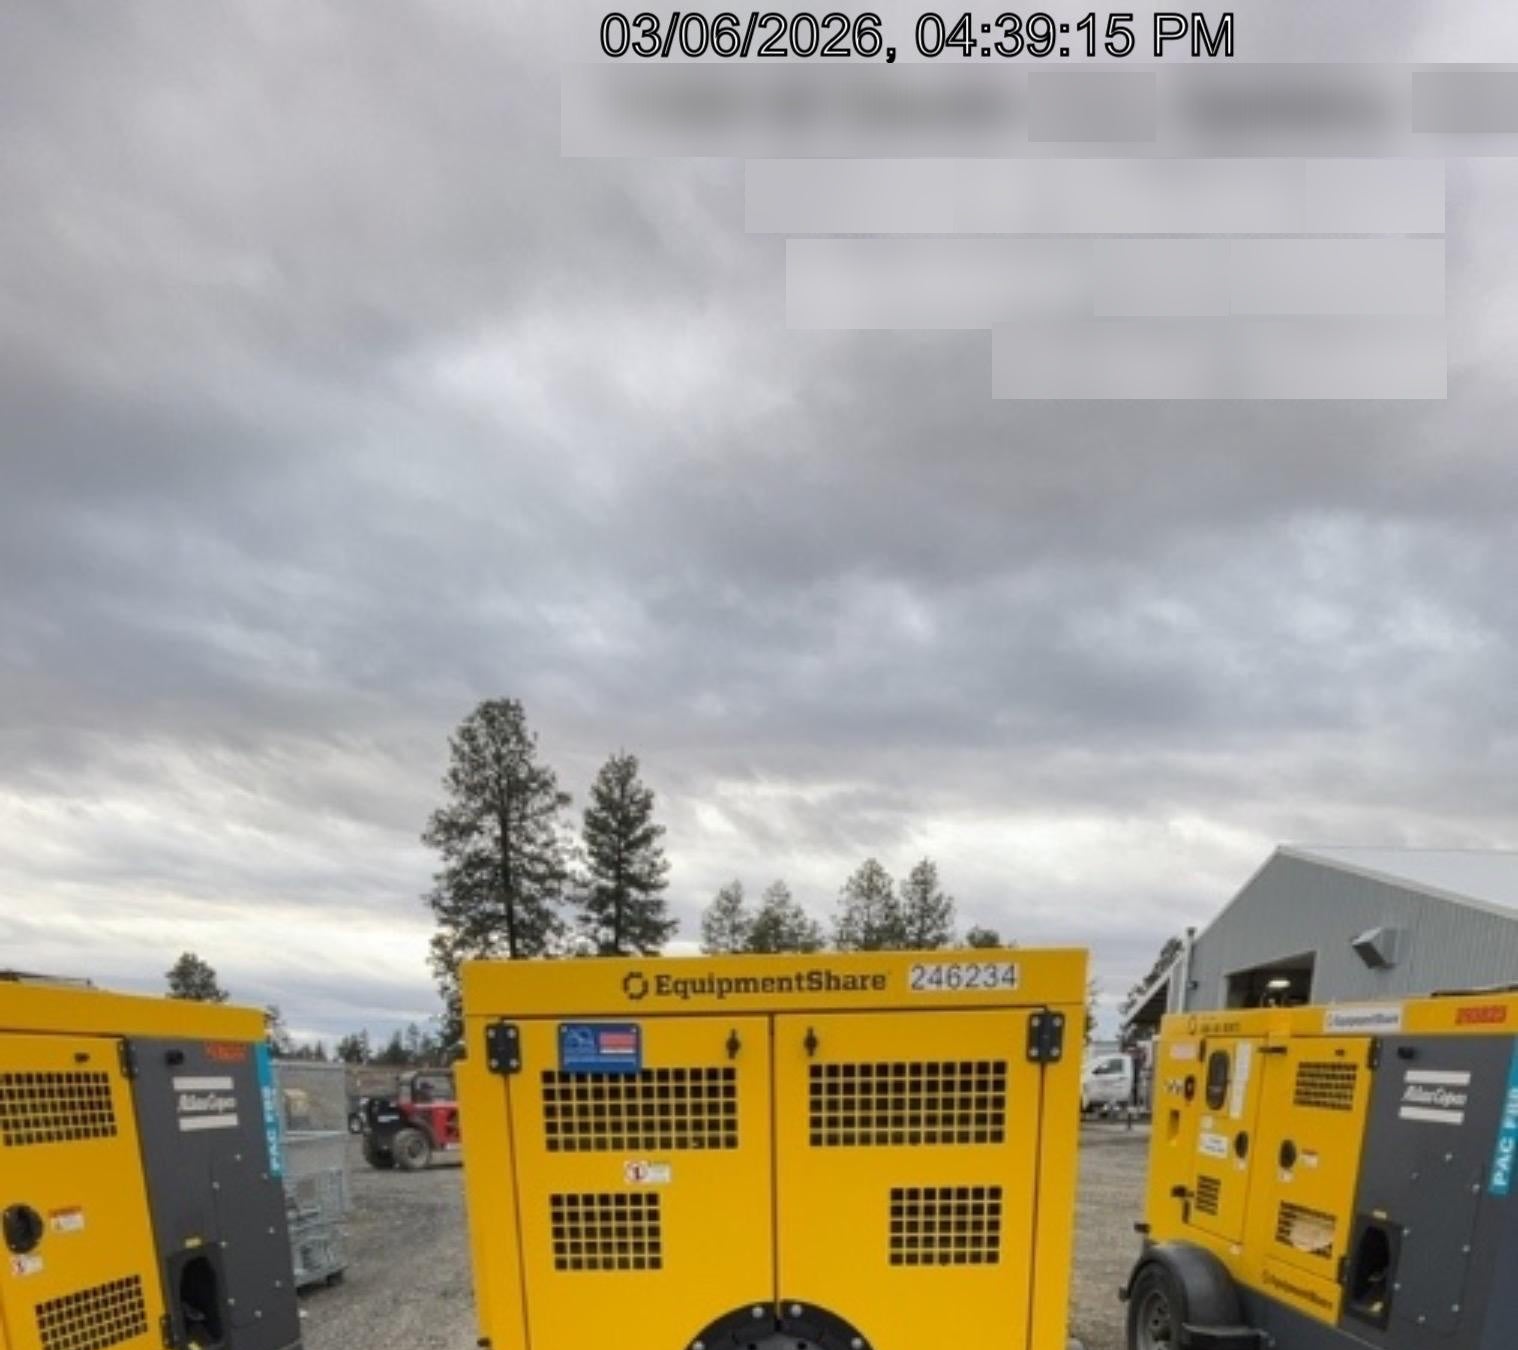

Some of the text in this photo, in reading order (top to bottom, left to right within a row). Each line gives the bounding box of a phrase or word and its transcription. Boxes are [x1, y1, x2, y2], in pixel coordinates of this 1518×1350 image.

[654, 970, 887, 999] EquipmentShare
[911, 963, 1017, 990] 246234
[1493, 1135, 1516, 1186] PAC
